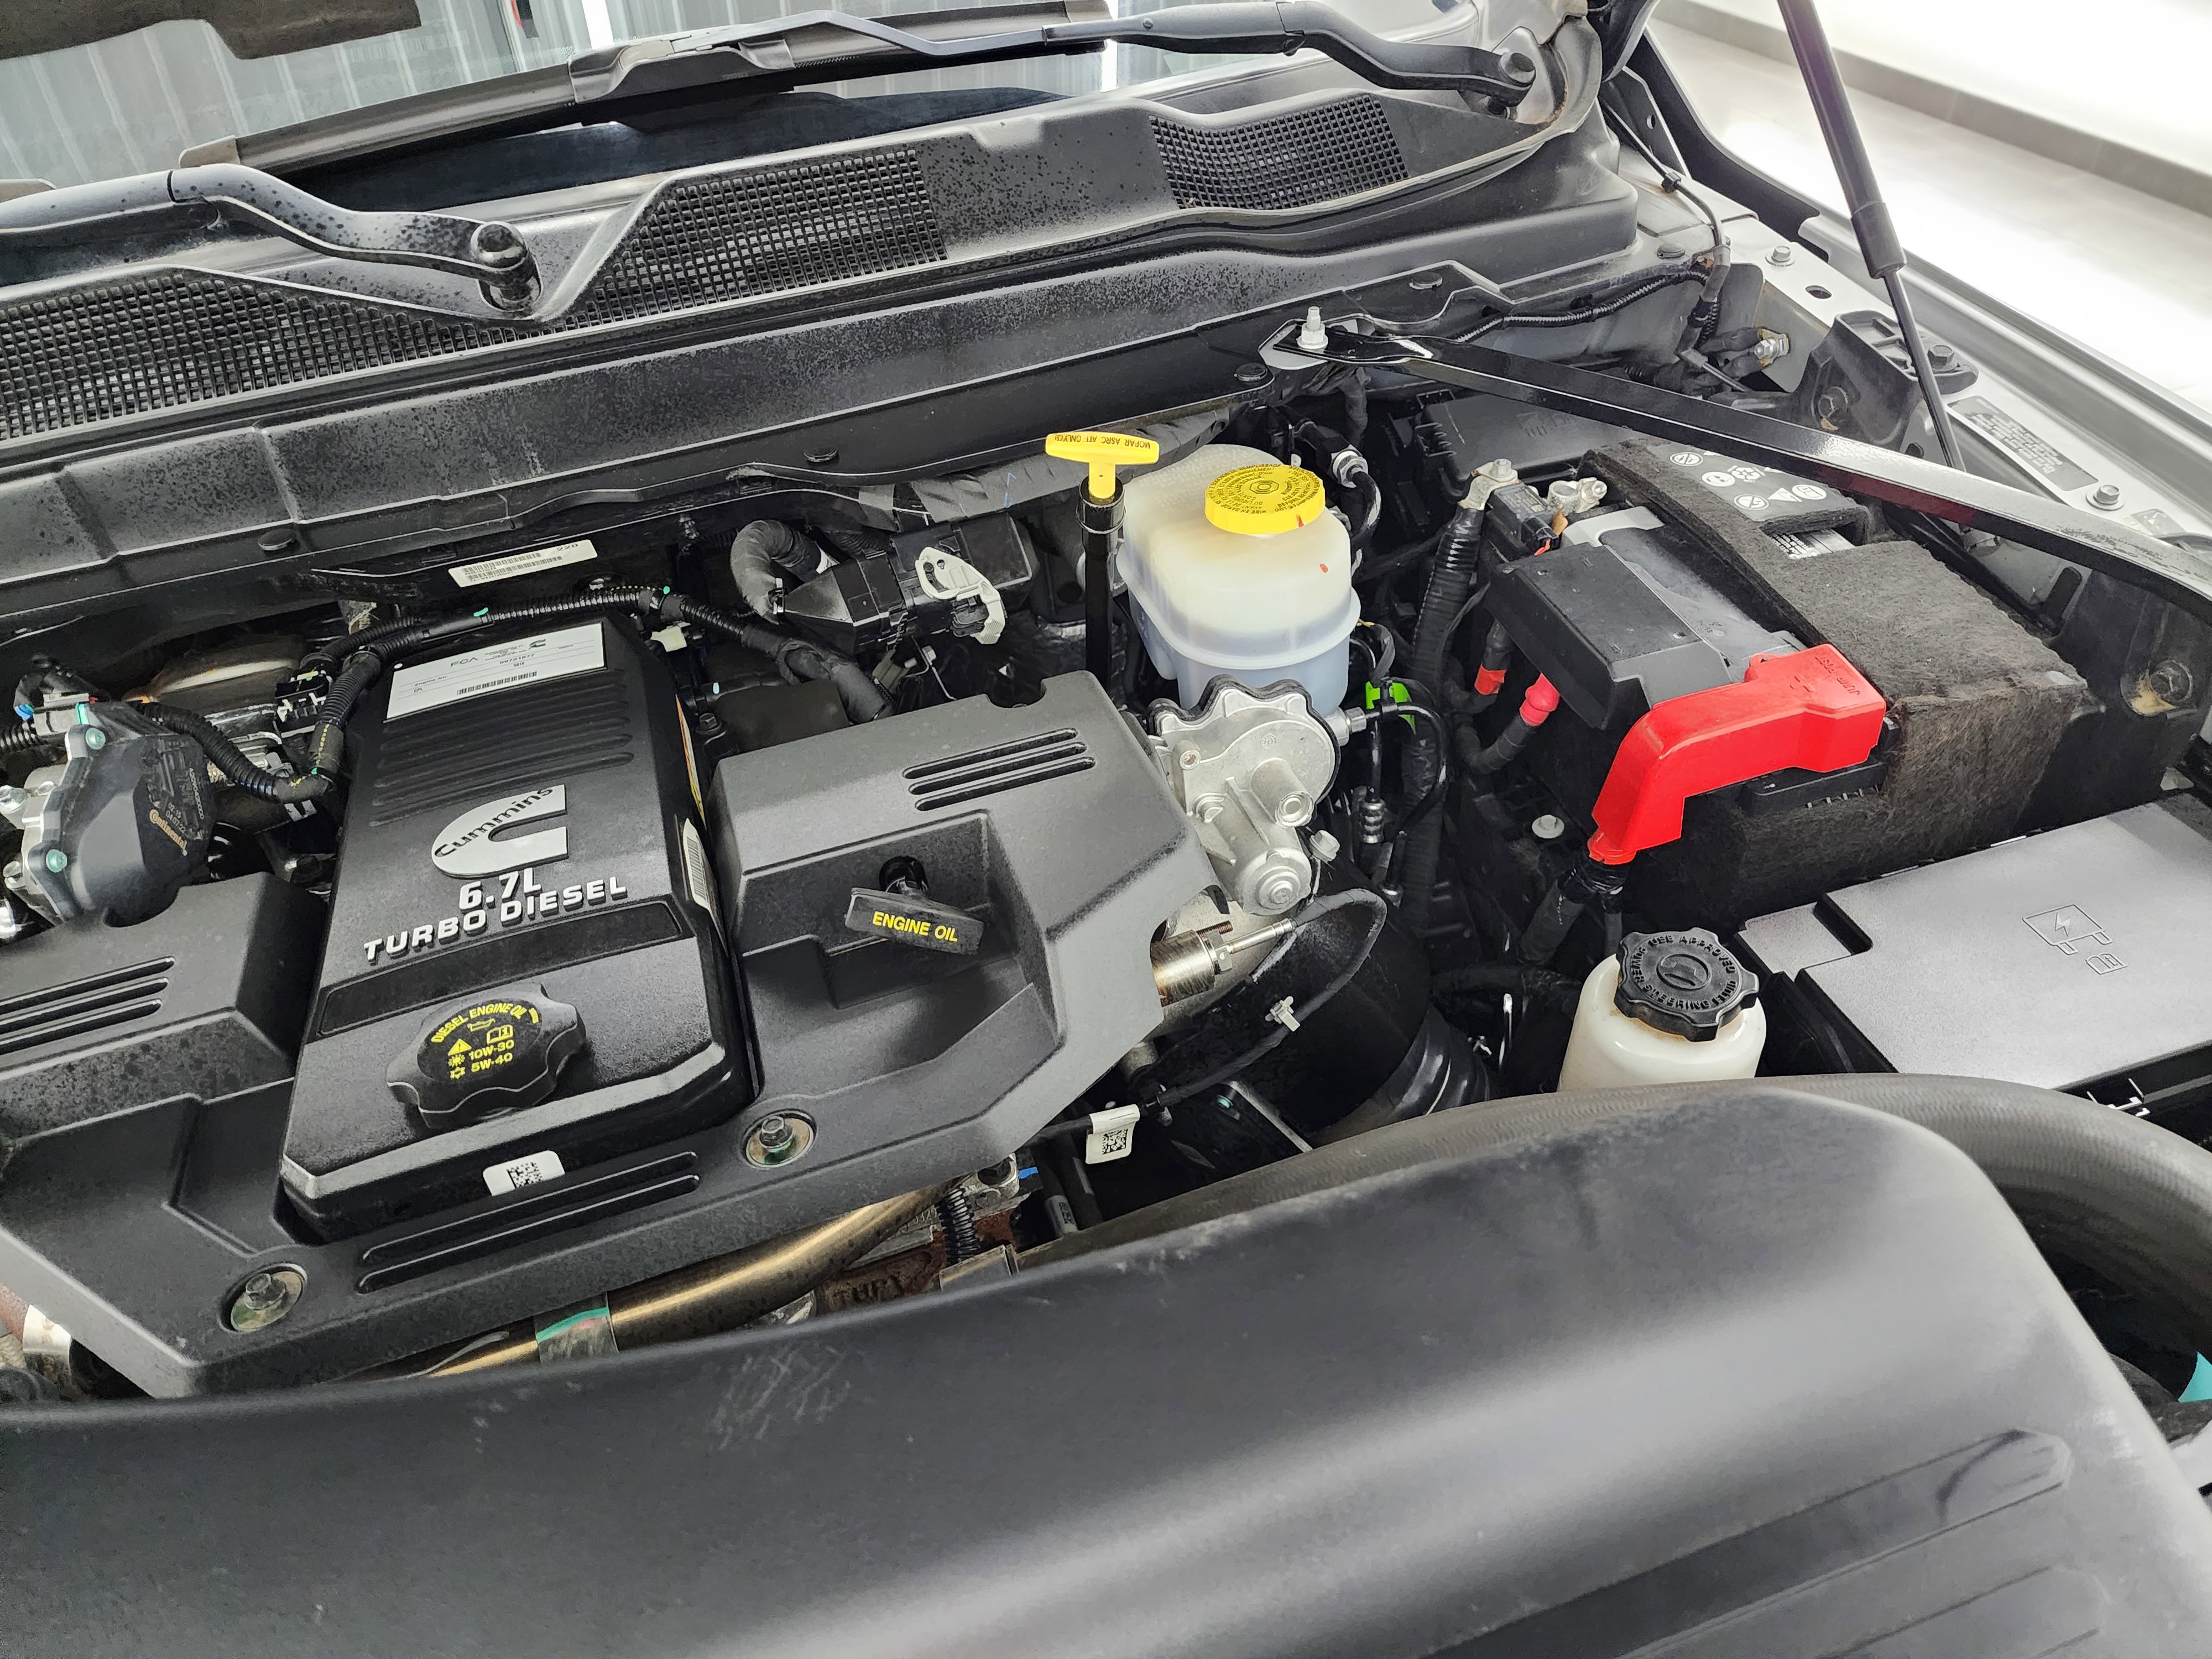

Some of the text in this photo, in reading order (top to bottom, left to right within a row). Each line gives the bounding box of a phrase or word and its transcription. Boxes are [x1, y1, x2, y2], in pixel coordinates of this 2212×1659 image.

[1100, 436, 1120, 445] ASRC
[1124, 439, 1151, 450] MOPAR
[557, 542, 579, 552] 220
[450, 656, 478, 667] FCA
[149, 808, 188, 852] Continental
[434, 786, 554, 858] Cummins
[458, 867, 541, 912] 6.7L
[363, 877, 627, 962] TURBO DIESEL
[872, 911, 958, 942] ENGINE OIL
[1647, 935, 1736, 974] USE APPROVED
[1631, 946, 1736, 1010] POWER STEERING FLUID
[431, 1015, 469, 1043] DIESEL
[469, 1003, 514, 1019] ENGINE
[510, 1005, 527, 1019] OIL
[469, 1039, 514, 1061] 10W-30
[471, 1052, 513, 1072] 5W-40
